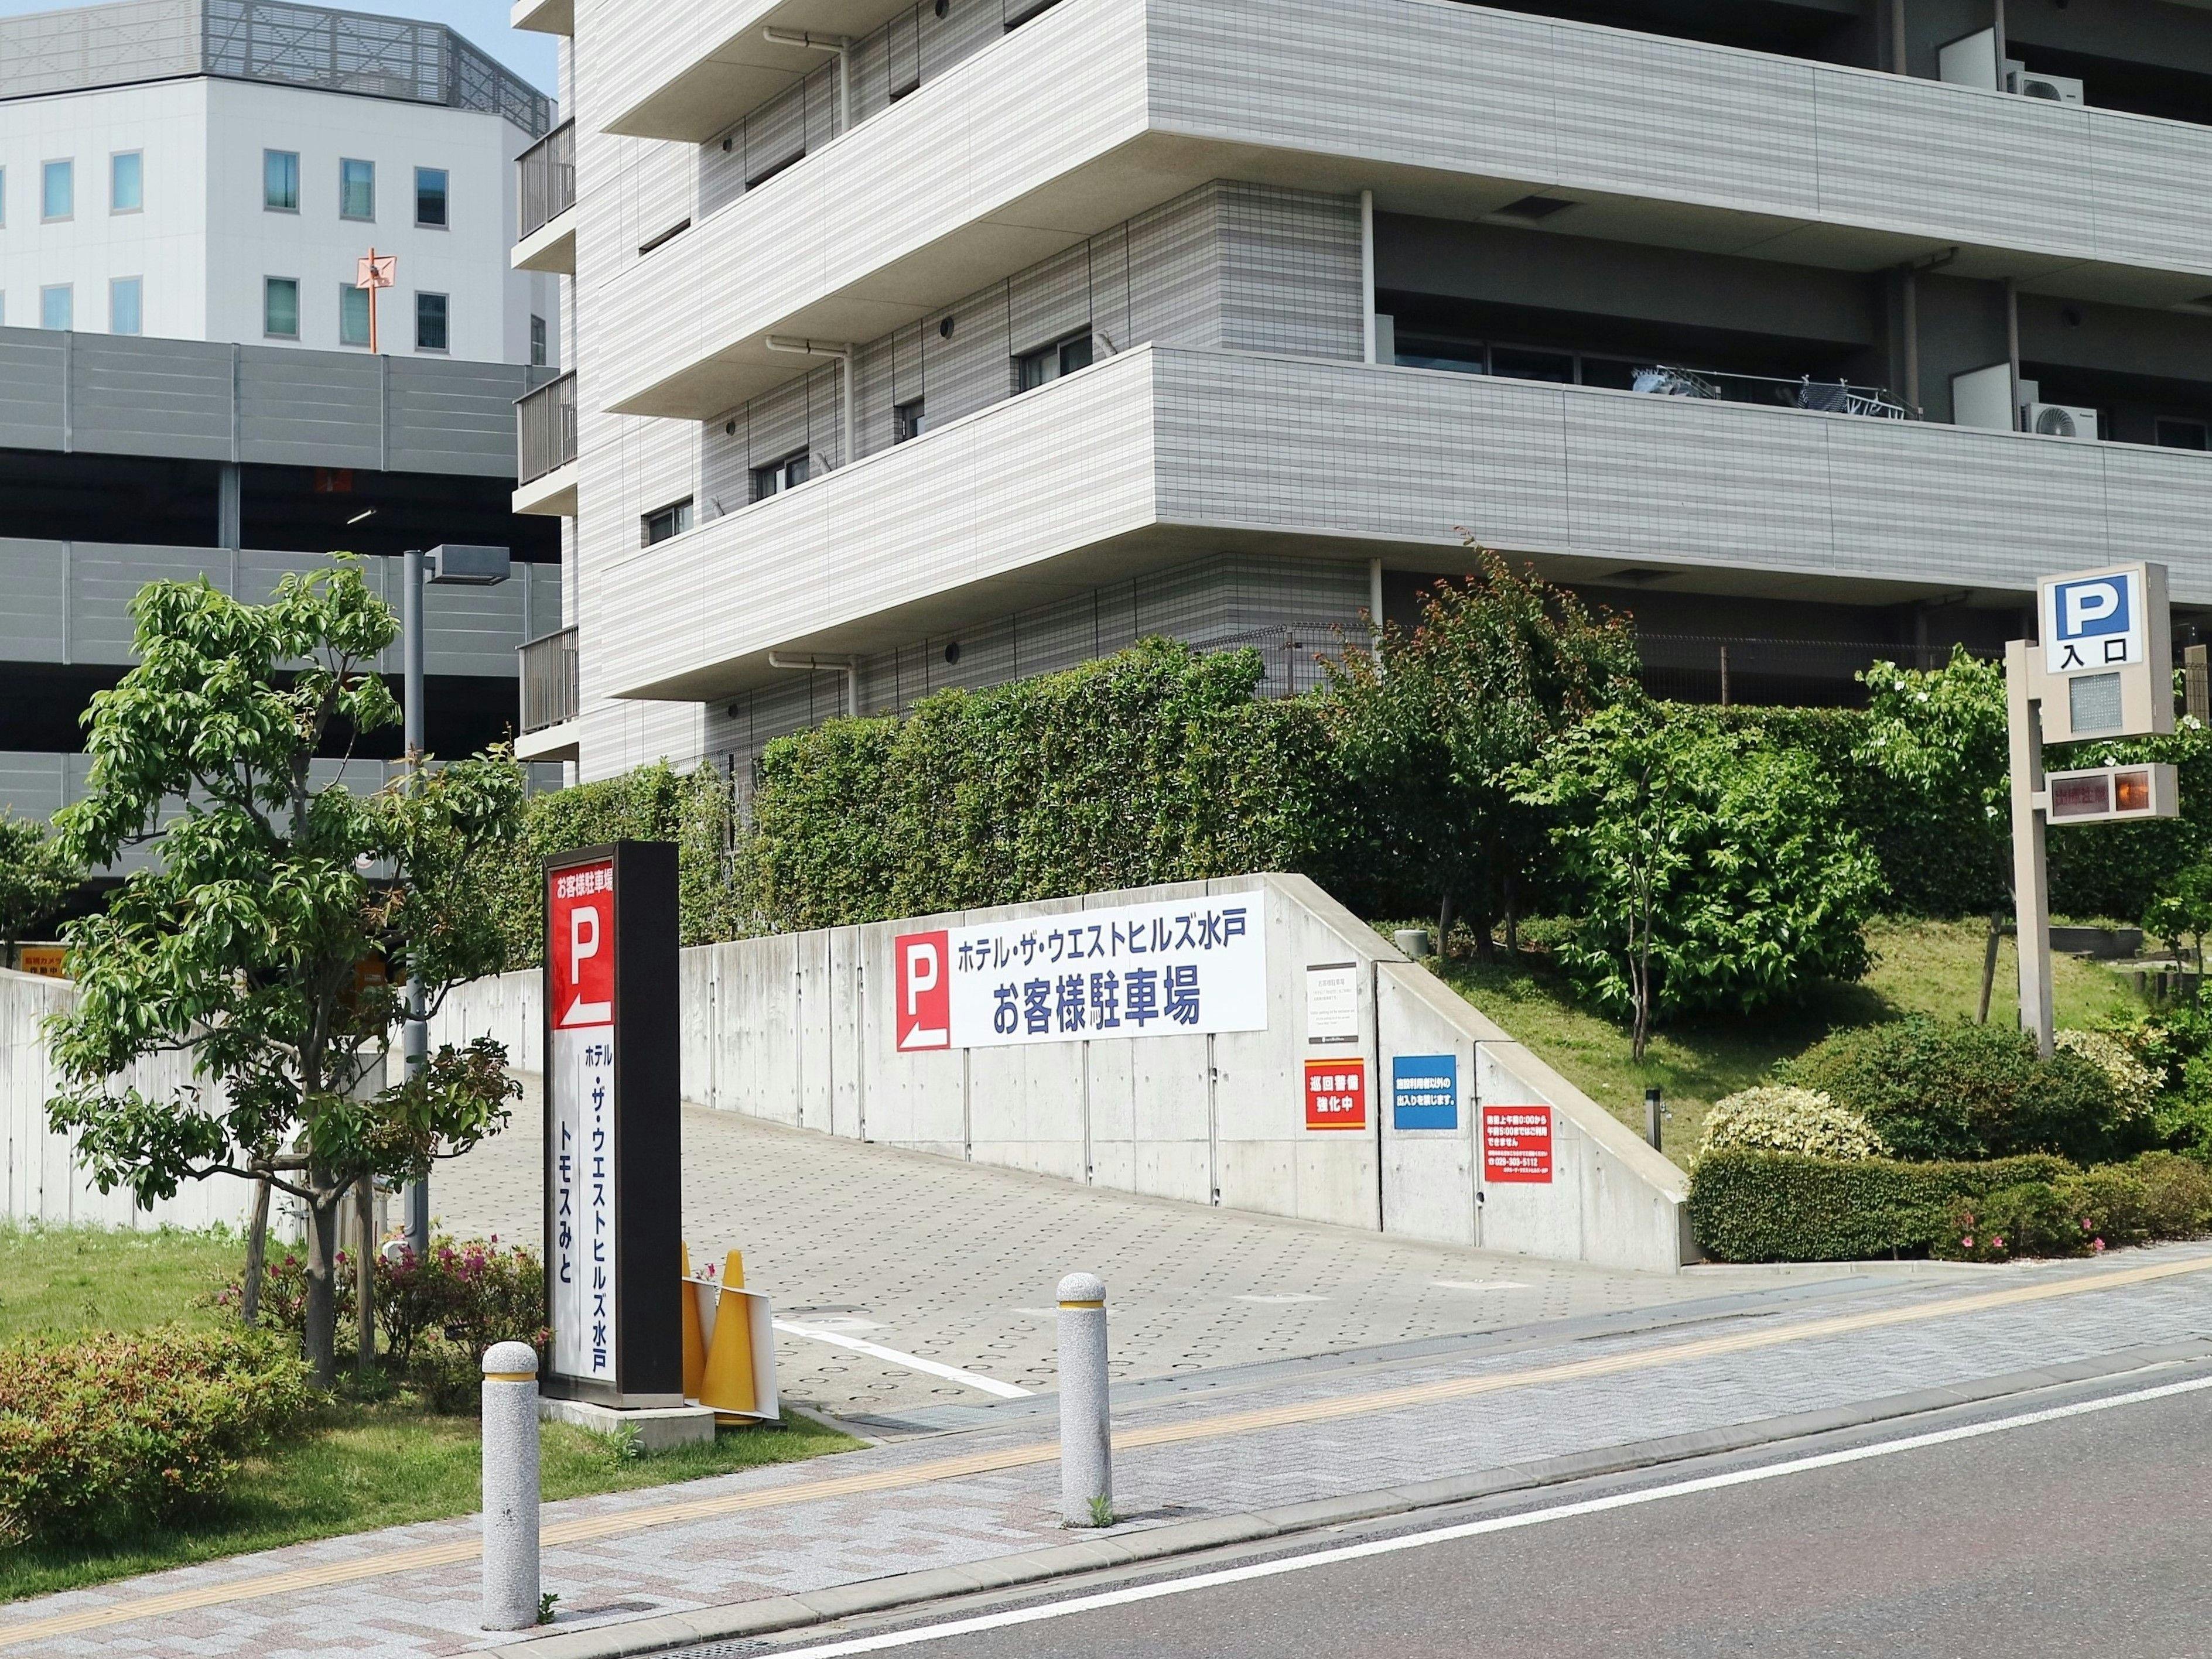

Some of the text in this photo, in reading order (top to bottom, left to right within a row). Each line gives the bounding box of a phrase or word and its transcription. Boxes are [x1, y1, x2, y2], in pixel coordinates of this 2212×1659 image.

[2066, 582, 2119, 635] P
[2061, 639, 2127, 669] 入口
[557, 868, 613, 899] お客様駐車場
[571, 905, 600, 984] P
[958, 908, 1246, 973] ホテル・ザ・ウエストヒルズ水戸
[907, 942, 938, 1015] P
[993, 965, 1200, 1035] お客様駐車場
[1310, 1074, 1359, 1092] 巡回警備
[1316, 1095, 1353, 1113] 強化中
[558, 1120, 572, 1284] トモスみと
